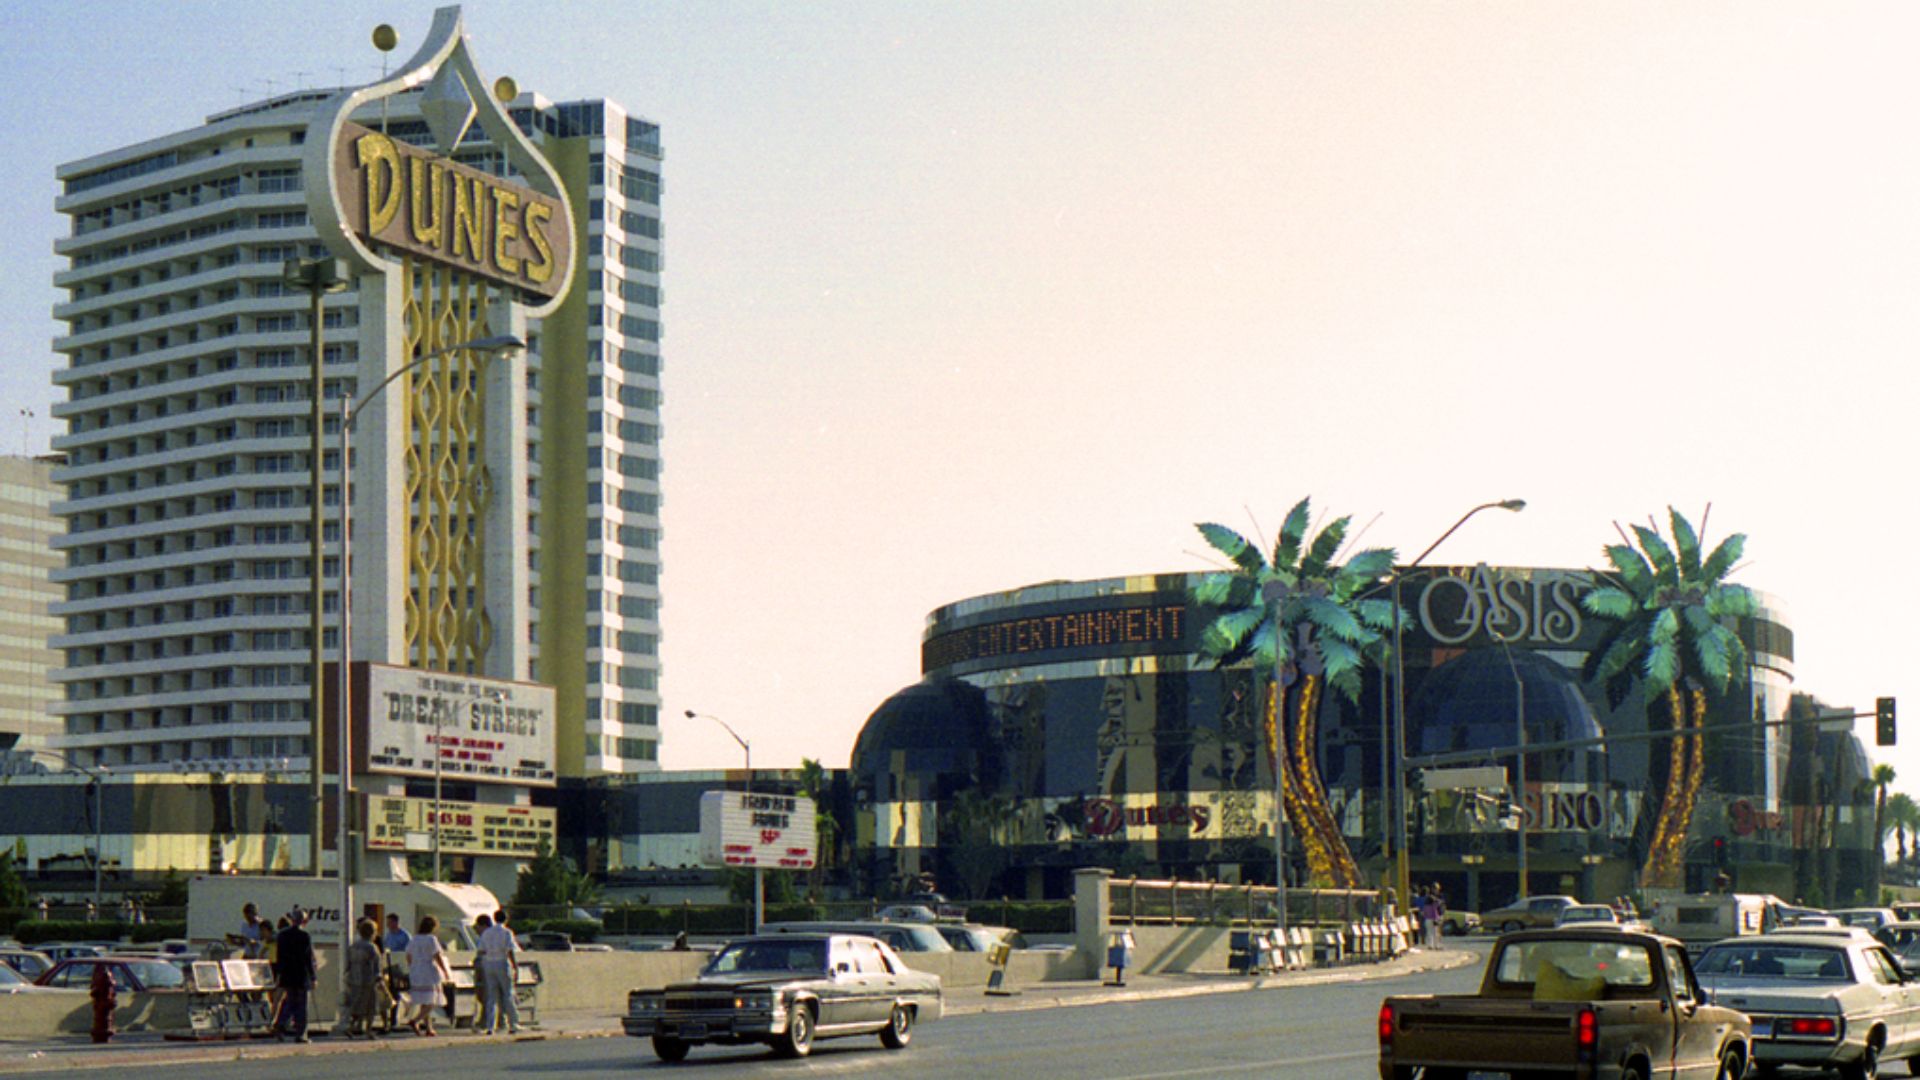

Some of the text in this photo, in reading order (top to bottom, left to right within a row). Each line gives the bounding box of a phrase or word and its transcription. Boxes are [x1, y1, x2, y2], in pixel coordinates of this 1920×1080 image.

[356, 133, 555, 284] DUNES
[977, 606, 1185, 657] ENTERTAINMENT
[1419, 562, 1581, 643] OASIS
[1084, 798, 1210, 835] Dunes
